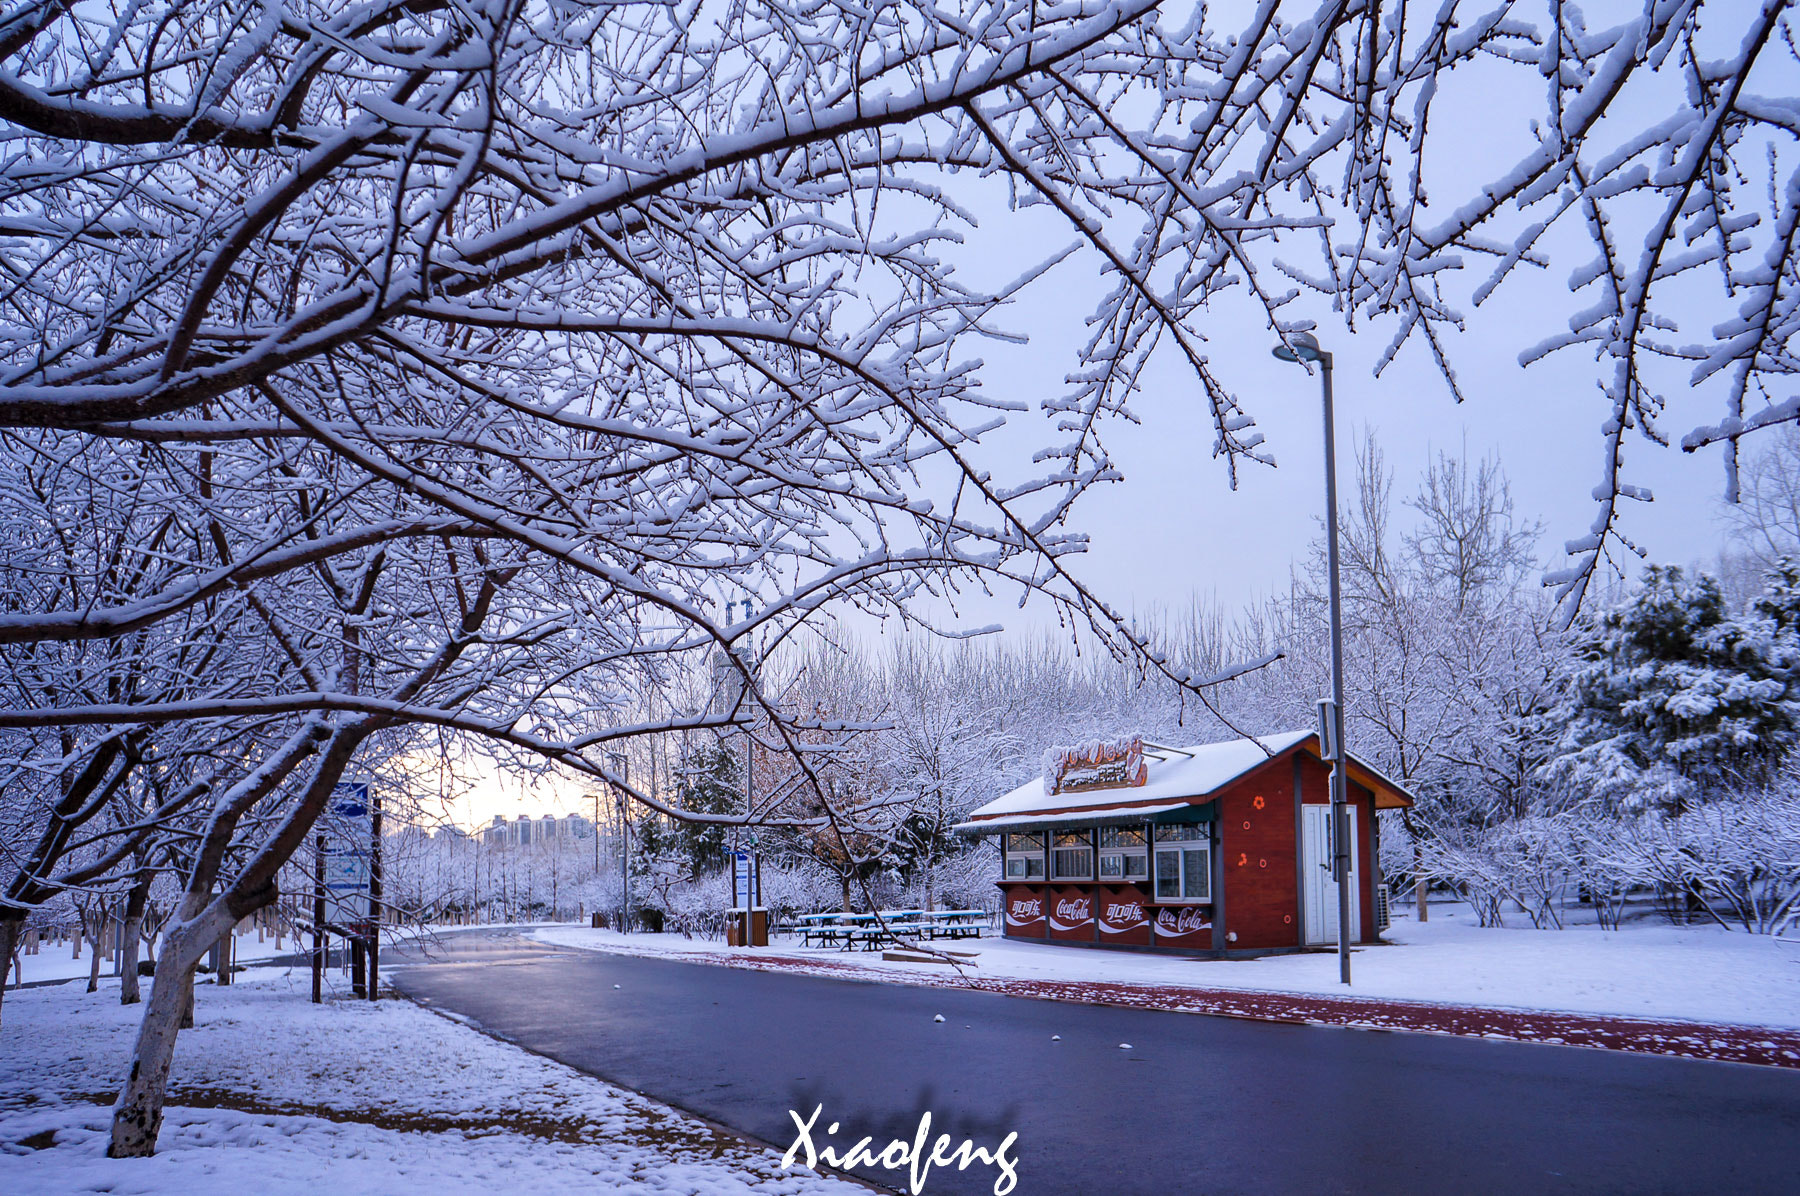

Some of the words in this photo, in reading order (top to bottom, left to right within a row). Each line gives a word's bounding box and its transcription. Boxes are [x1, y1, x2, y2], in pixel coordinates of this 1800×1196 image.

[1012, 898, 1042, 918] 可口可乐
[1106, 901, 1143, 923] 可口可乐
